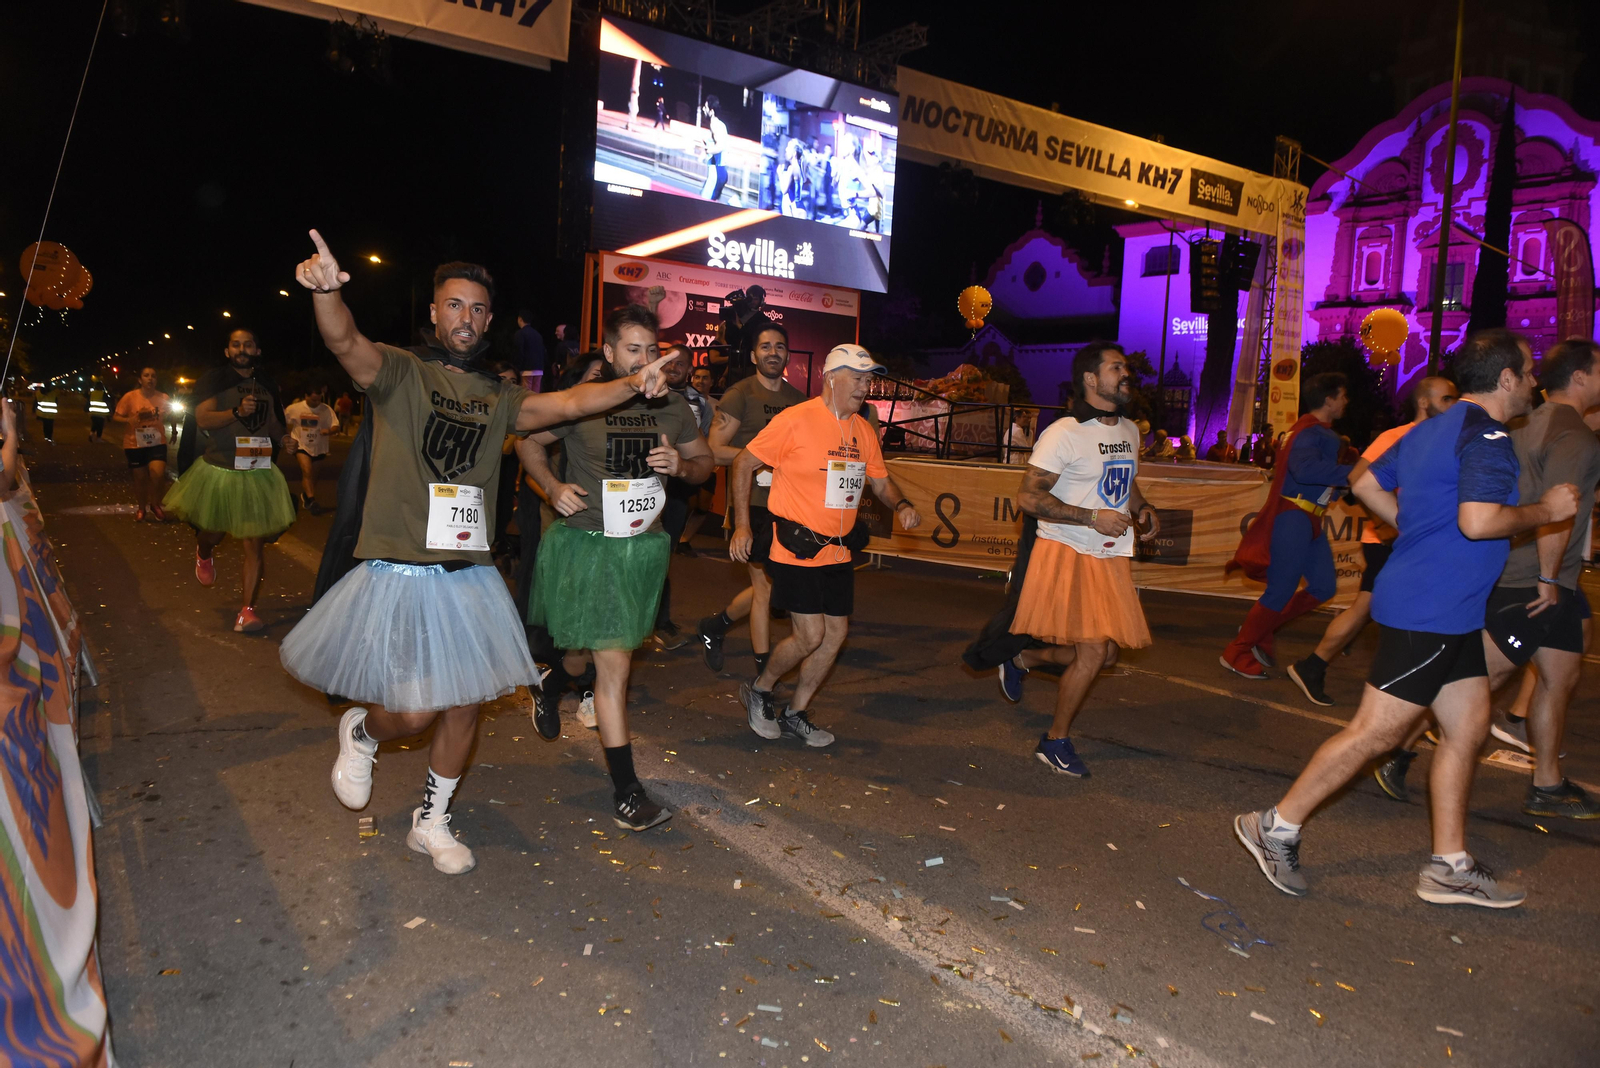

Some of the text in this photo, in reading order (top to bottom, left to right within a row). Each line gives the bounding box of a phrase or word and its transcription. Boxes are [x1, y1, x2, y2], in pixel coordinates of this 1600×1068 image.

[902, 94, 1039, 157] NOCTURNA
[1044, 135, 1133, 181] SEVILLA
[656, 271, 672, 280] ABC
[679, 275, 710, 287] Cruzcampo
[705, 323, 714, 331] 30
[431, 390, 490, 416] CrossFit
[605, 413, 658, 427] CrossFit
[249, 447, 263, 456] 984
[838, 446, 860, 454] NOCTURNA
[1098, 440, 1132, 455] CrossFit
[828, 450, 849, 458] SEVILLA
[619, 496, 656, 513] 12523
[451, 507, 479, 524] 7180
[971, 534, 1014, 546] Instituto
[987, 546, 1000, 555] de
